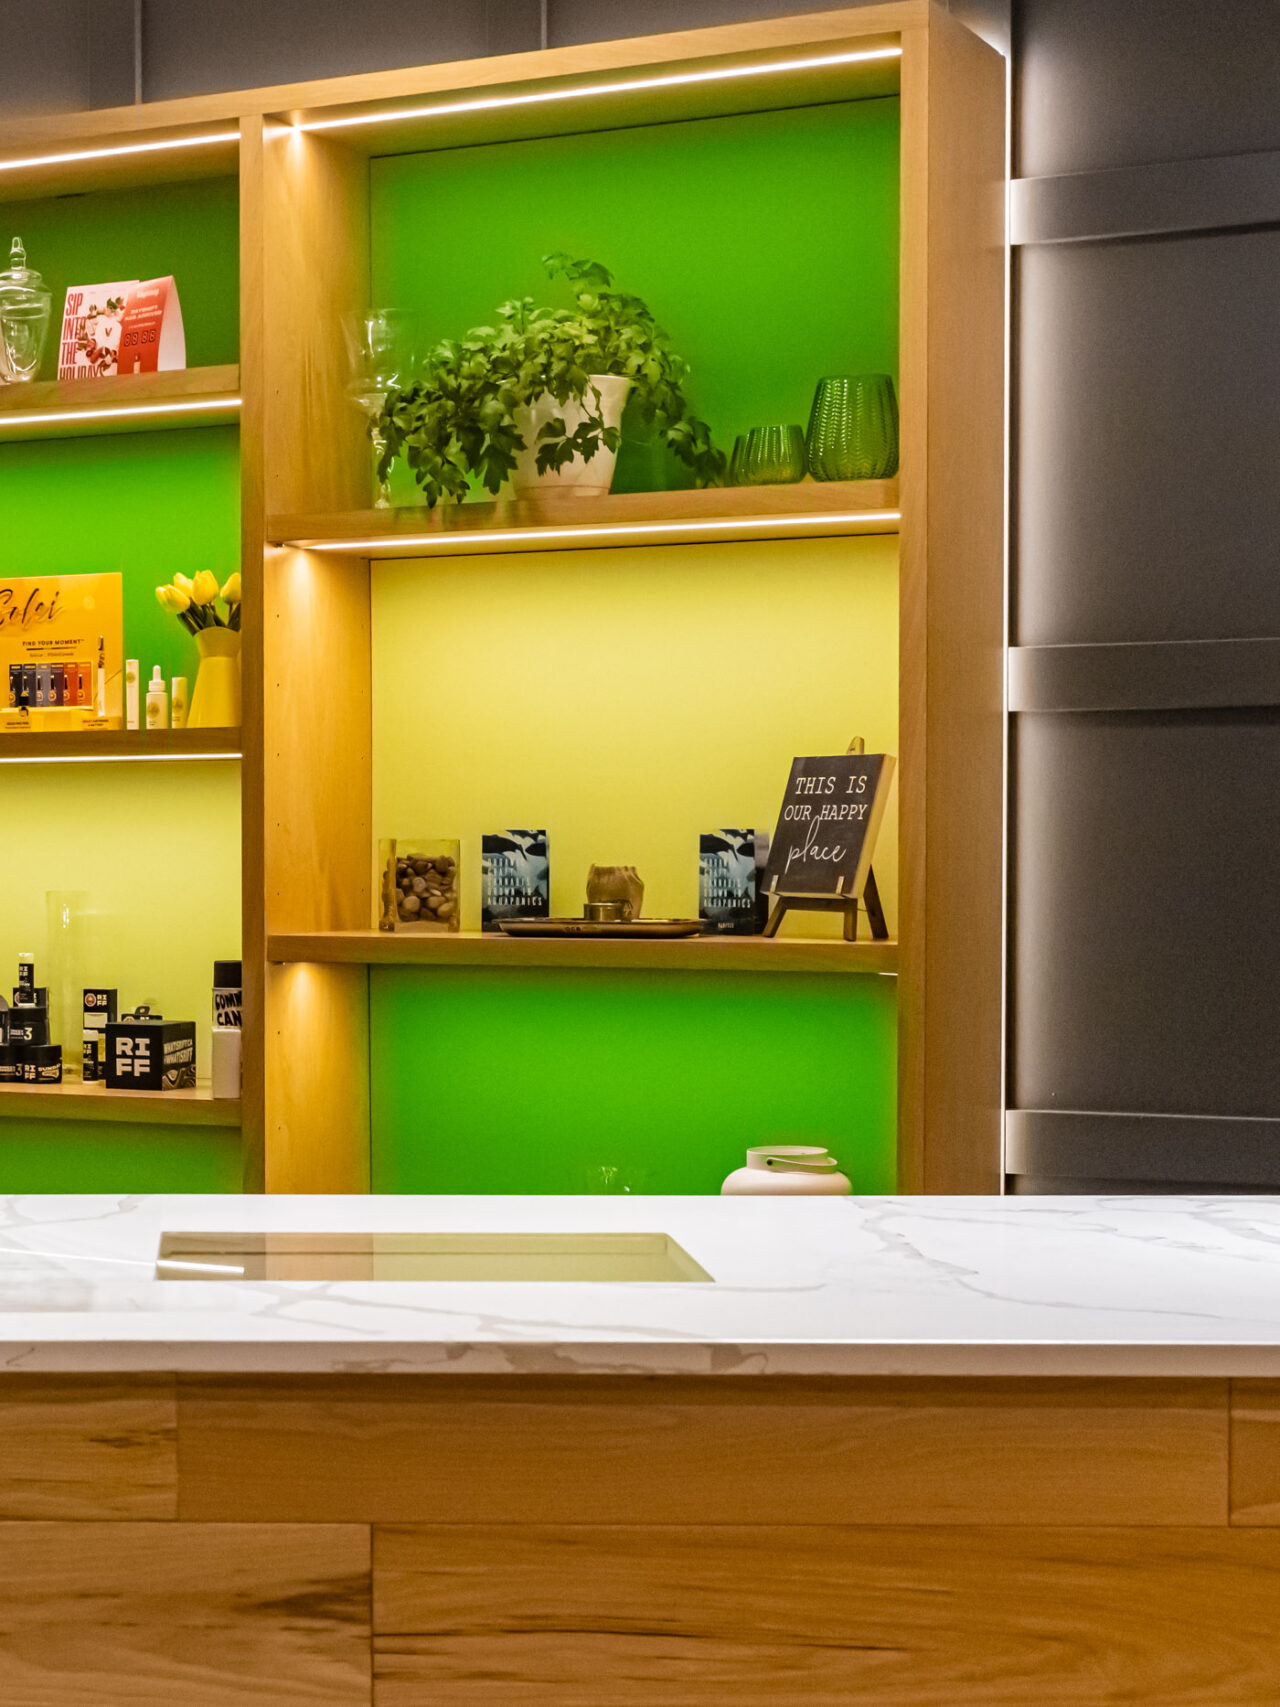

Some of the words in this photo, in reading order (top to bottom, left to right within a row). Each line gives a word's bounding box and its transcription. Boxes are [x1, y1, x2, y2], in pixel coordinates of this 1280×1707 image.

[66, 293, 84, 316] SIP
[62, 341, 79, 366] THE
[795, 776, 836, 795] THIS
[845, 775, 868, 794] IS
[784, 805, 812, 820] OUR
[820, 804, 868, 820] HAPPY
[785, 815, 847, 875] place
[24, 1028, 33, 1040] 3
[116, 1037, 150, 1056] RI
[116, 1058, 150, 1077] FF
